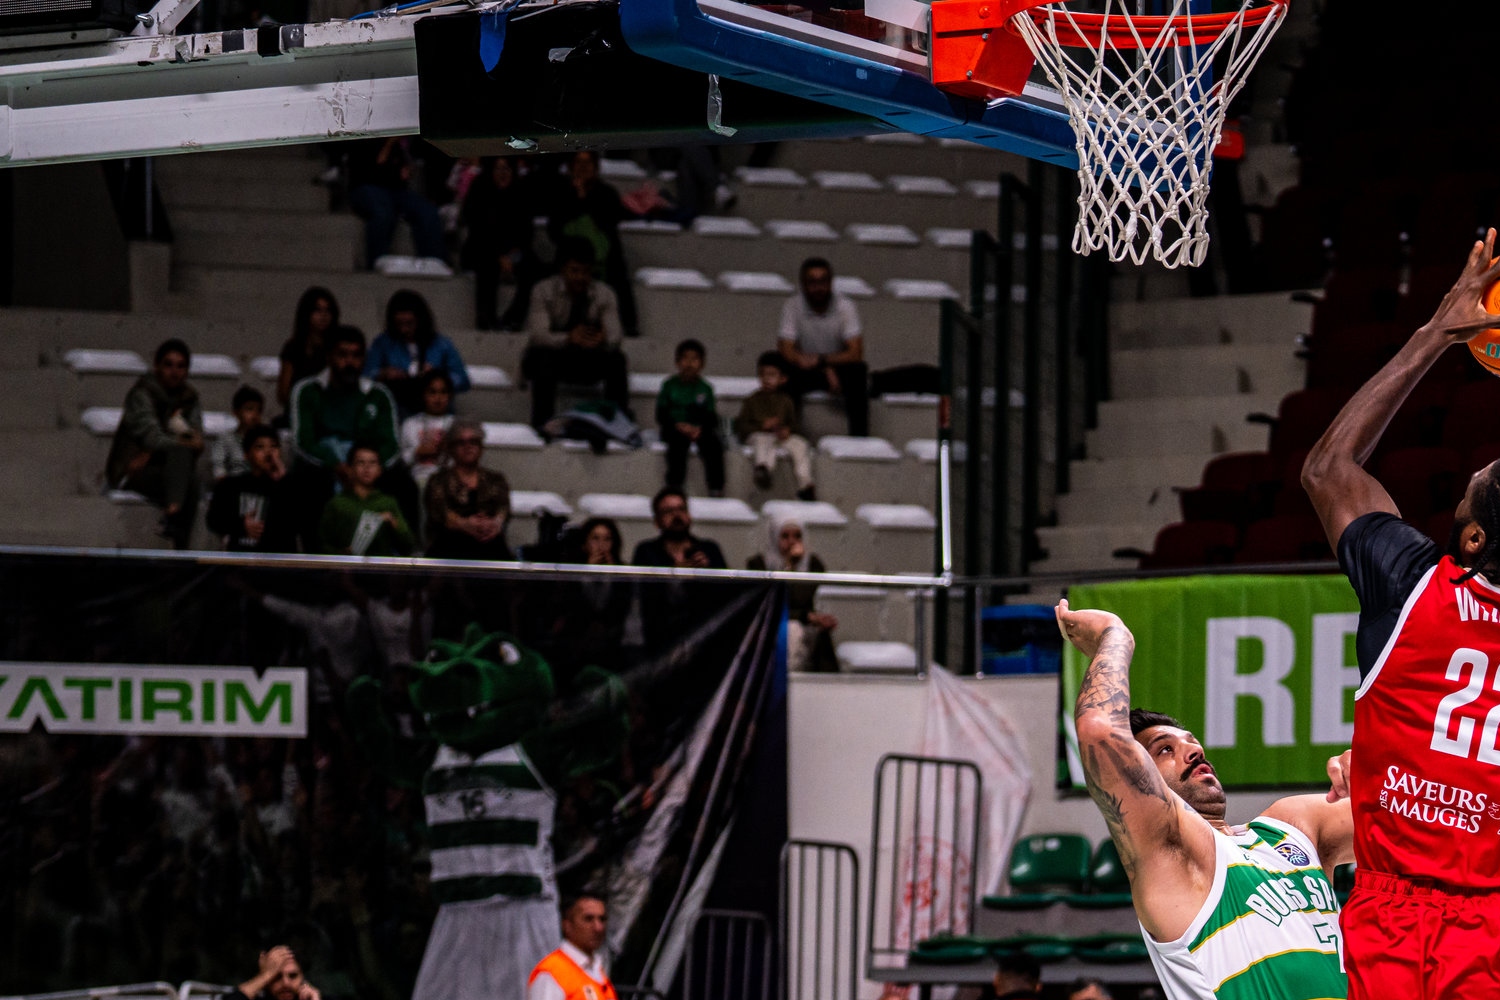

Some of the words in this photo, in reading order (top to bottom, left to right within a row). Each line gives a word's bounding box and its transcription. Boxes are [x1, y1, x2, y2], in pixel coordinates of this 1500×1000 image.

[1379, 789, 1389, 809] DES
[1383, 765, 1488, 812] SAVEURS
[1390, 796, 1482, 834] MAUGES
